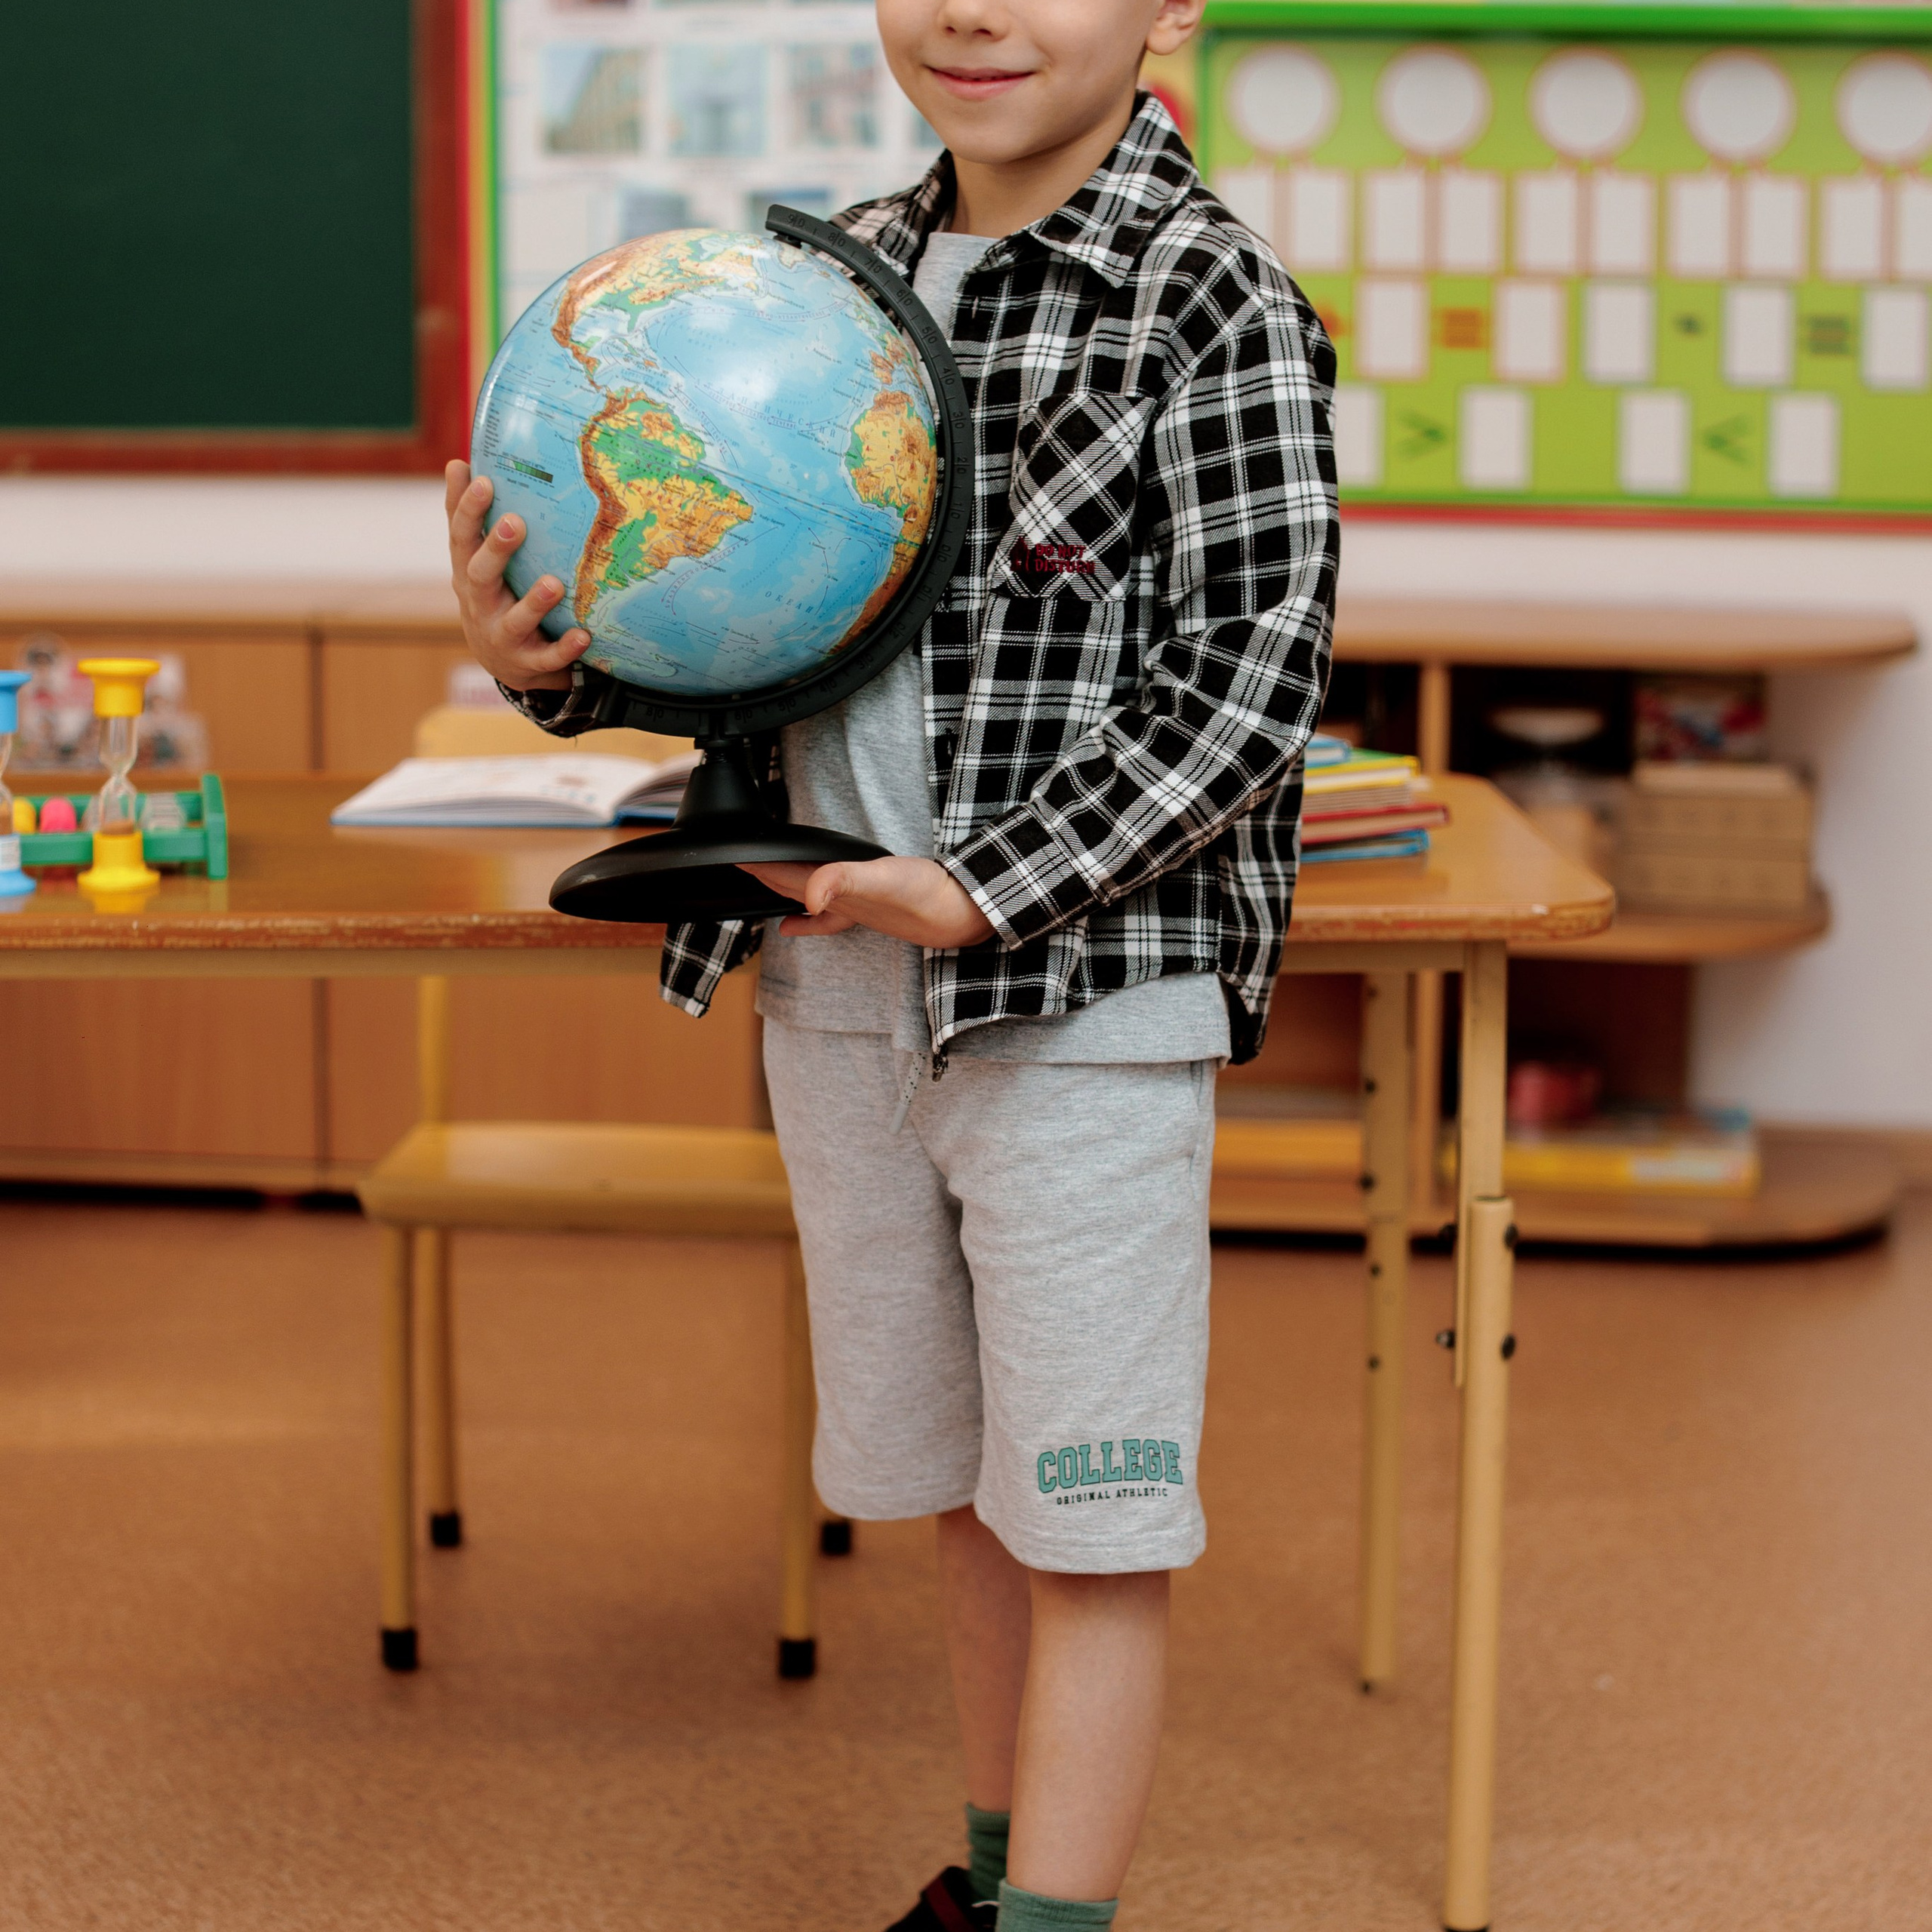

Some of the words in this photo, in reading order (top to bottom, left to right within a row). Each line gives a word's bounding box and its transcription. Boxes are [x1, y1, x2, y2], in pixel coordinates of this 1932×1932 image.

[1035, 543, 1054, 557] DO
[1057, 543, 1087, 558] NOT
[1034, 558, 1096, 574] DISTURB
[1037, 1438, 1183, 1494] COLLEGE
[1057, 1490, 1111, 1505] ORIGINAL
[1116, 1487, 1169, 1499] ATHLETIC
